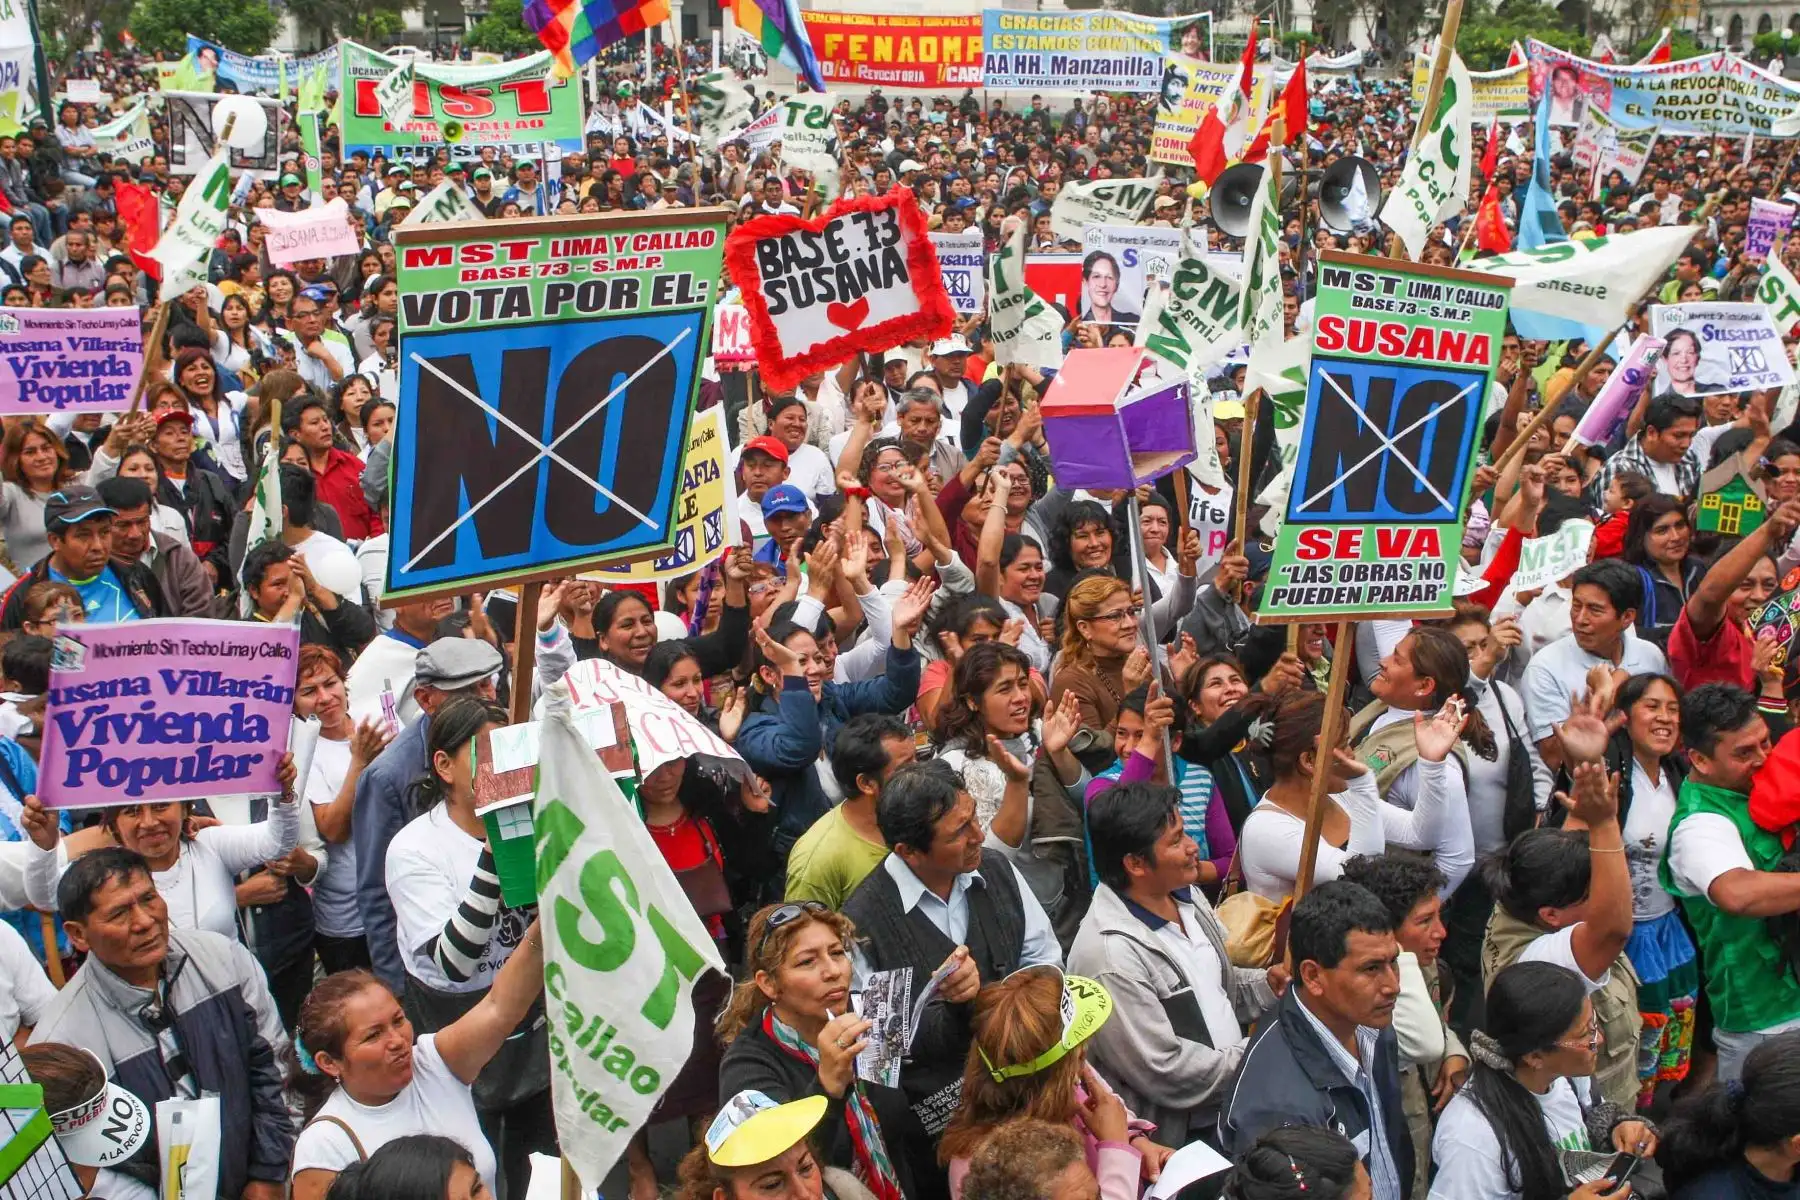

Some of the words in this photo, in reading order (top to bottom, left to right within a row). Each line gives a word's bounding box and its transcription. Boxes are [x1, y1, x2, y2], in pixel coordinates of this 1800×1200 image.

[1000, 15, 1085, 32] GRACIAS
[824, 33, 983, 64] FENAOMP
[992, 34, 1081, 50] ESTAMOS
[857, 64, 925, 83] REVOCATORIA
[985, 54, 1008, 75] AA
[1014, 55, 1046, 75] HH.
[1051, 55, 1153, 77] Manzanilla
[1018, 78, 1061, 87] Virgen
[1614, 77, 1632, 89] NO
[1650, 78, 1666, 90] LA
[1671, 76, 1758, 97] REVOCATORIA
[1763, 87, 1781, 102] DE
[1656, 93, 1718, 106] ABAJO
[1723, 94, 1740, 108] LA
[463, 119, 545, 132] CALLAO
[1626, 104, 1646, 117] EL
[1652, 109, 1745, 124] PROYECTO
[1176, 125, 1197, 134] DESAR
[1155, 136, 1189, 150] COMIT
[1170, 153, 1194, 163] REVOC
[403, 241, 541, 268] MST
[550, 236, 607, 258] LIMA
[615, 236, 628, 252] Y
[632, 230, 715, 253] CALLAO
[757, 218, 850, 281] BASE
[939, 253, 984, 267] usana
[461, 265, 531, 282] BASE
[537, 262, 569, 277] 73
[592, 255, 663, 273] S.M.P.
[763, 246, 910, 316] SUSANA
[1322, 268, 1402, 295] MST
[1407, 281, 1441, 301] LIMA
[1445, 286, 1456, 302] Y
[1456, 288, 1505, 310] CALLAO
[402, 284, 533, 327] VOTA
[544, 277, 640, 315] POR
[651, 272, 709, 306] EL:
[957, 297, 976, 309] va
[991, 293, 1024, 314] llao
[1352, 295, 1394, 312] BASE
[1398, 301, 1417, 314] 73
[1429, 306, 1472, 322] S.M.P.
[1758, 275, 1800, 323] ST
[719, 308, 752, 350] MS
[1315, 316, 1491, 366] SUSANA
[1702, 323, 1776, 342] Susana
[66, 336, 144, 354] Villarán
[7, 353, 133, 379] Vivienda
[1728, 377, 1750, 388] se
[1755, 372, 1783, 386] va
[17, 377, 132, 410] Popular
[408, 334, 678, 571] NO
[1303, 372, 1469, 515] NO
[680, 457, 721, 495] AFIA
[1191, 494, 1225, 525] ife
[1295, 528, 1364, 561] SE
[1375, 528, 1442, 559] VA
[1280, 564, 1334, 584] “LAS
[1338, 563, 1413, 583] OBRAS
[1418, 562, 1446, 581] NO
[1269, 586, 1361, 606] PUEDEN
[1366, 583, 1448, 604] PARAR”
[92, 640, 158, 659] Movimiento
[159, 641, 180, 657] Sin
[181, 641, 219, 657] Techo
[219, 641, 249, 657] Lima
[248, 645, 257, 661] y
[258, 641, 292, 660] Callao
[50, 675, 151, 707] usana
[158, 668, 294, 705] Villarán
[53, 700, 271, 748] Vivienda
[62, 744, 264, 797] Popular
[544, 960, 661, 1095] Callao
[923, 1089, 945, 1105] GRAN
[101, 1097, 134, 1145] NO
[917, 1105, 933, 1116] DEL
[921, 1111, 938, 1124] CON
[937, 1106, 949, 1116] LA
[99, 1153, 108, 1162] A
[109, 1149, 125, 1160] LA
